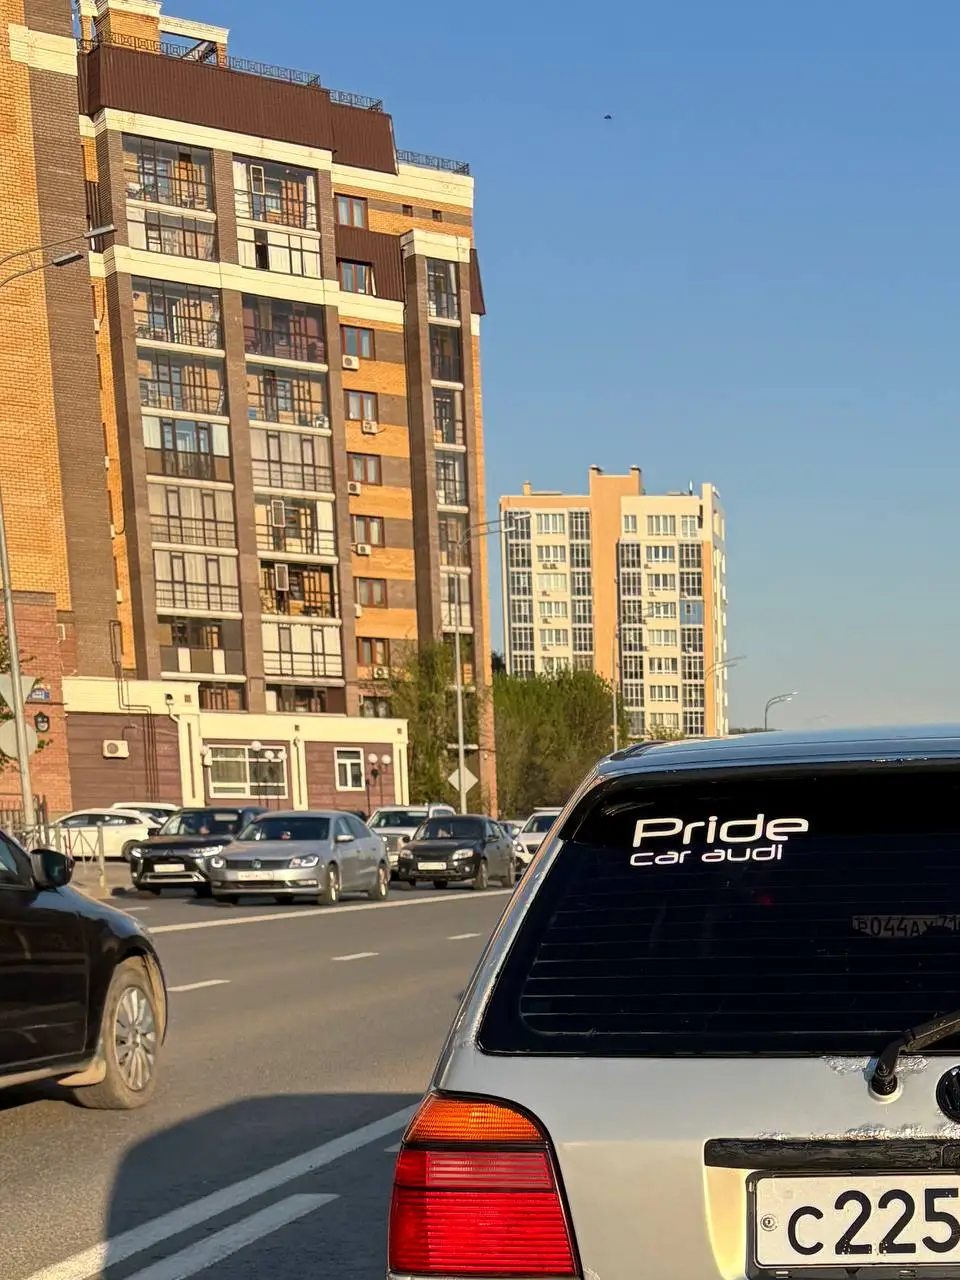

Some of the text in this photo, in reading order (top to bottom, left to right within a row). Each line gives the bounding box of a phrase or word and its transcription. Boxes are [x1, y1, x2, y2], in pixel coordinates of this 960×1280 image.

[632, 813, 809, 848] Pride
[629, 844, 783, 867] car audi
